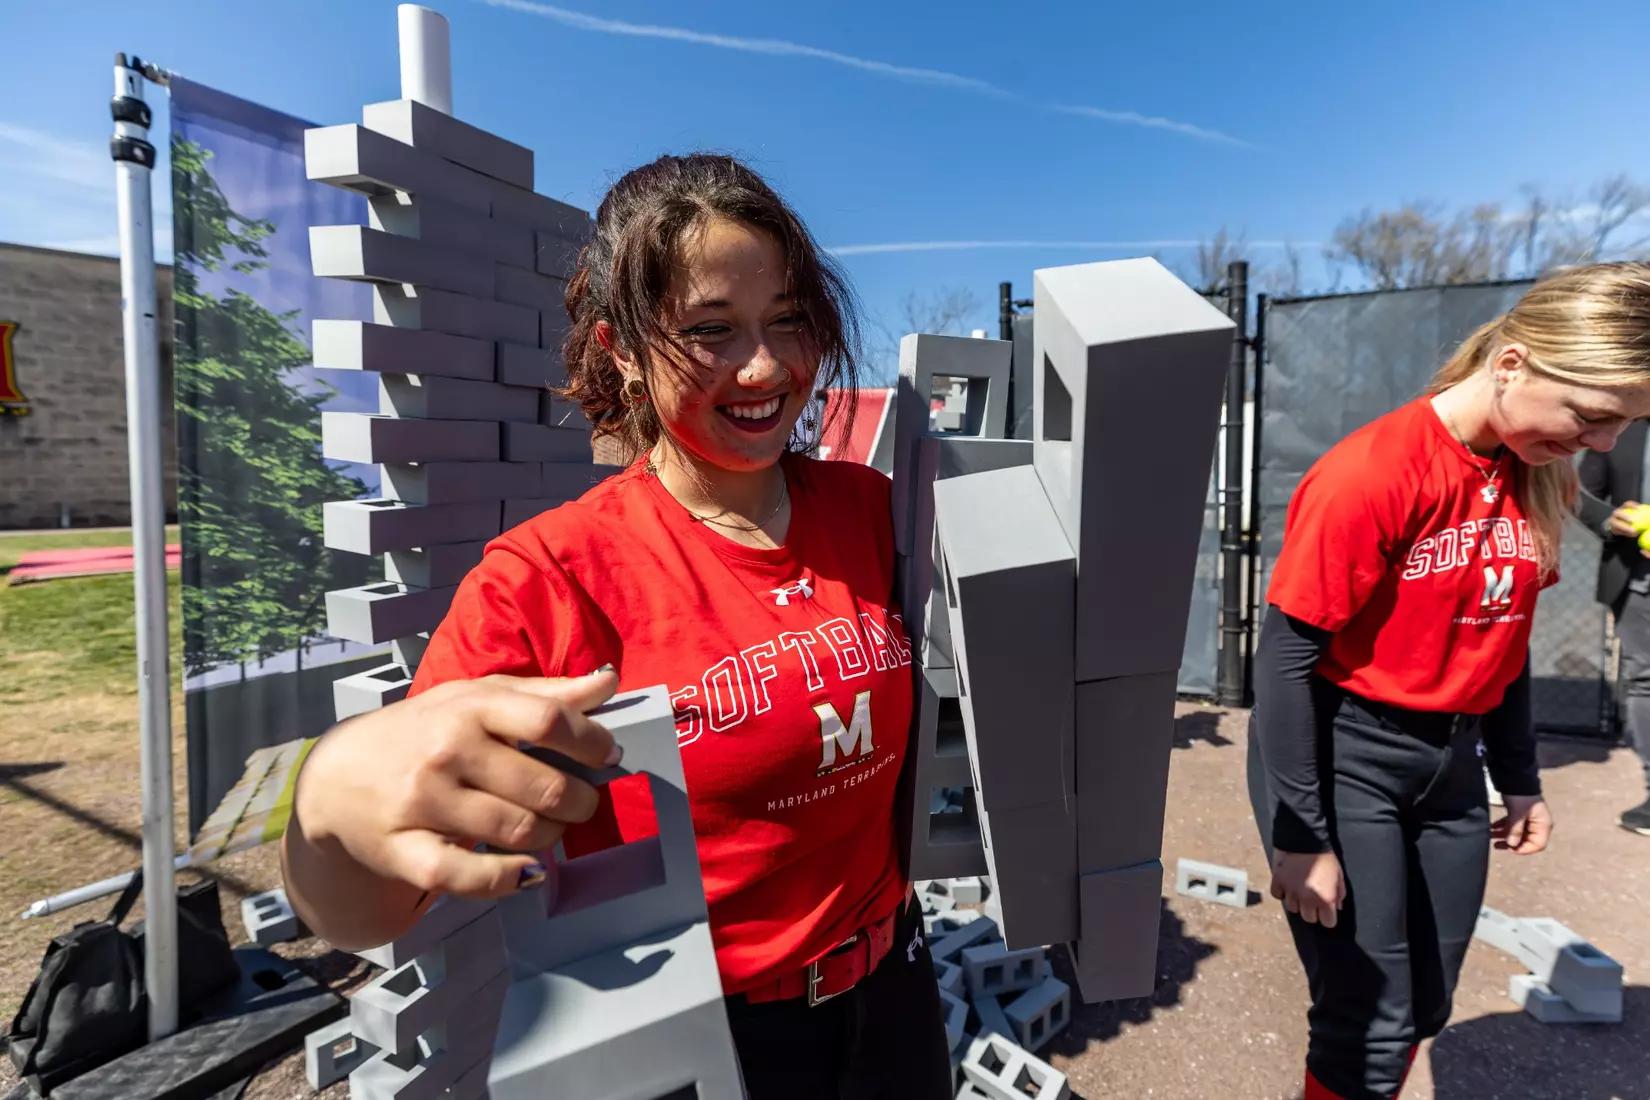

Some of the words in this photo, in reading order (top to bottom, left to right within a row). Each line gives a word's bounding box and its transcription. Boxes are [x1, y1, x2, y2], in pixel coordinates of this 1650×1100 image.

[1480, 565, 1515, 606] M
[812, 690, 875, 770] M
[767, 785, 836, 812] MARYLAND
[843, 752, 896, 789] TERRAPINS
